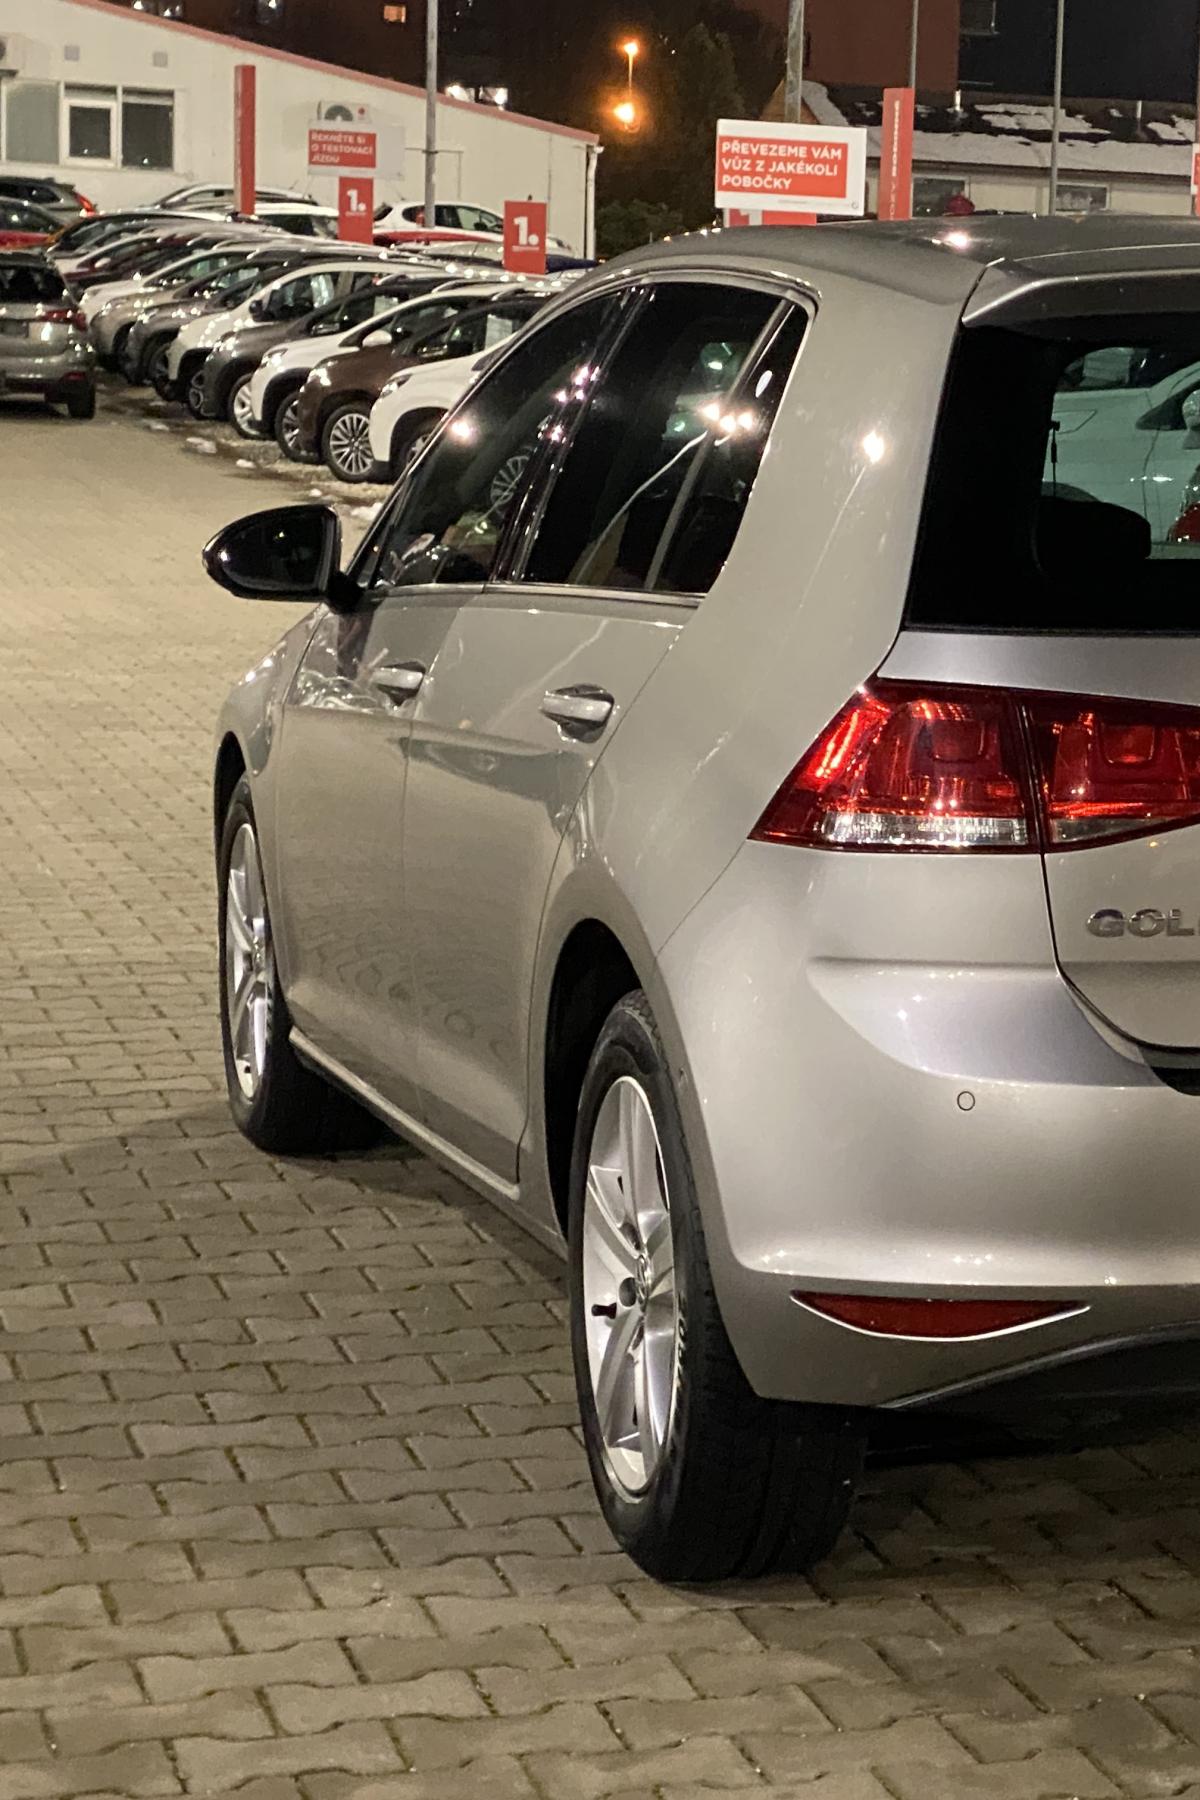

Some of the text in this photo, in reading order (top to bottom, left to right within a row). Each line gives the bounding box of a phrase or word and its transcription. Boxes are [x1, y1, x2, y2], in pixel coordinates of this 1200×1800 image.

[721, 141, 842, 160] PŘEVEZEME VÁM
[721, 157, 838, 176] VŮZ Z JAKÉKOLI
[721, 174, 793, 189] POBOČKY
[346, 188, 367, 212] 1.
[513, 216, 539, 245] 1.
